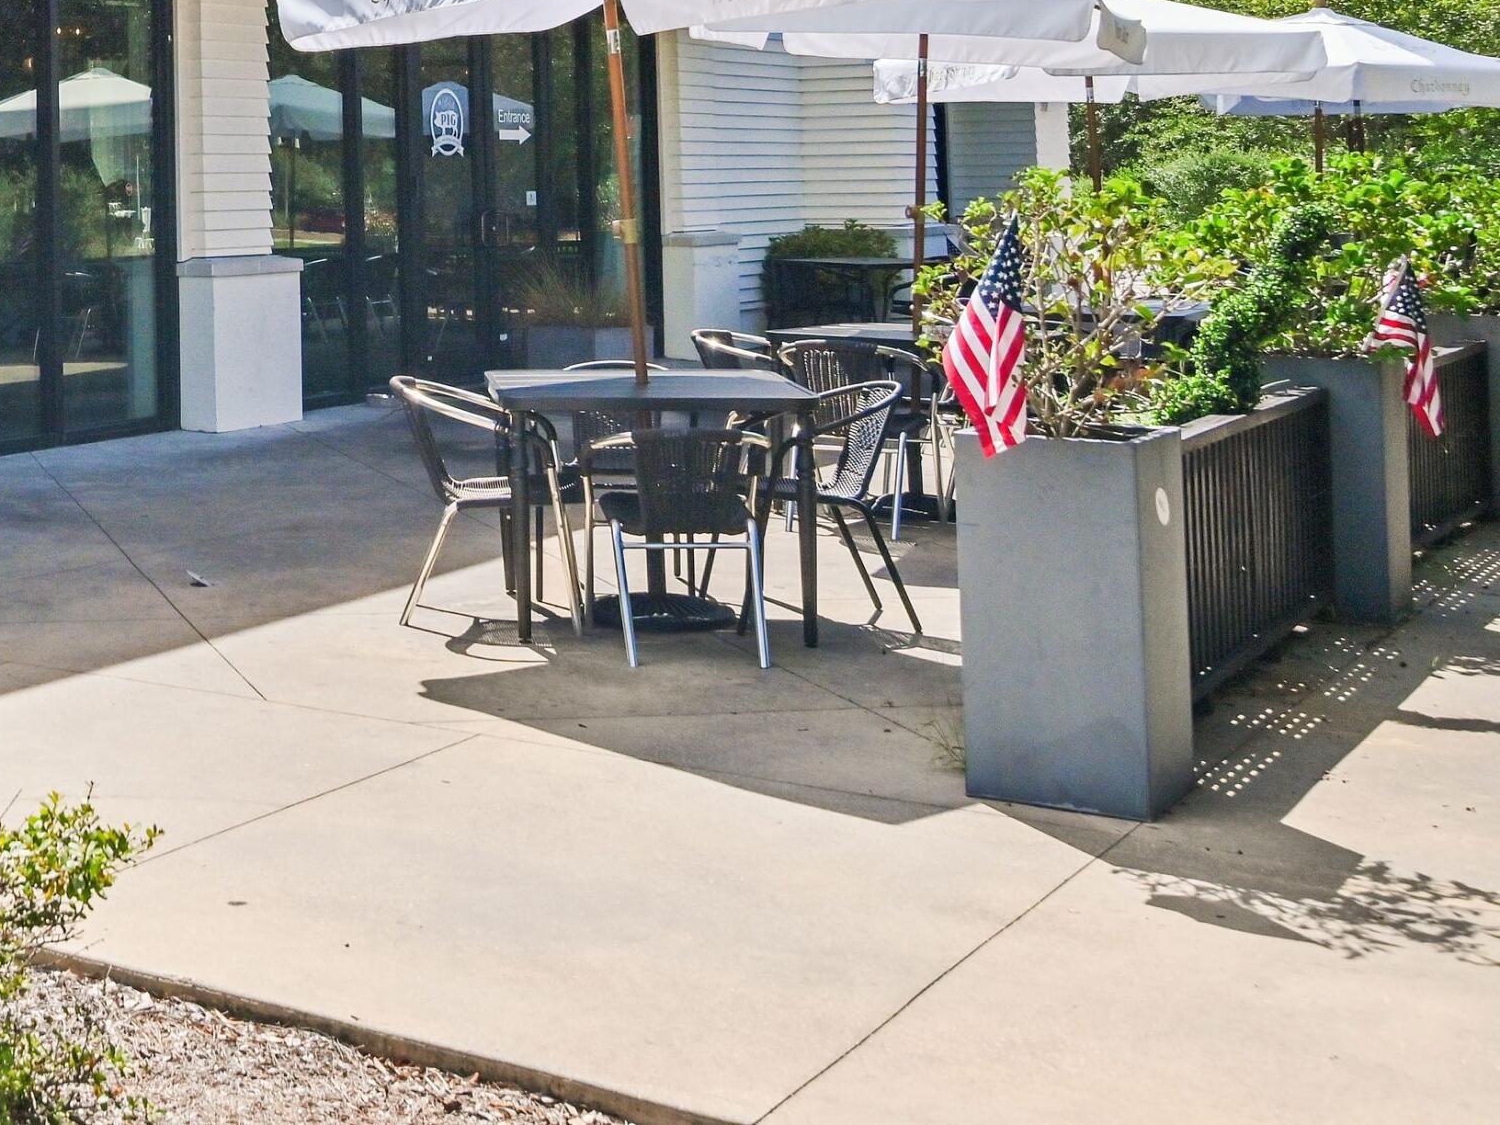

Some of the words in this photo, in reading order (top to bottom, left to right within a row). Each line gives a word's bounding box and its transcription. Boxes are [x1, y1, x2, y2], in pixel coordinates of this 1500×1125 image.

[1410, 76, 1470, 96] Chardonnay
[440, 113, 457, 126] PIG
[498, 109, 531, 124] Entrance
